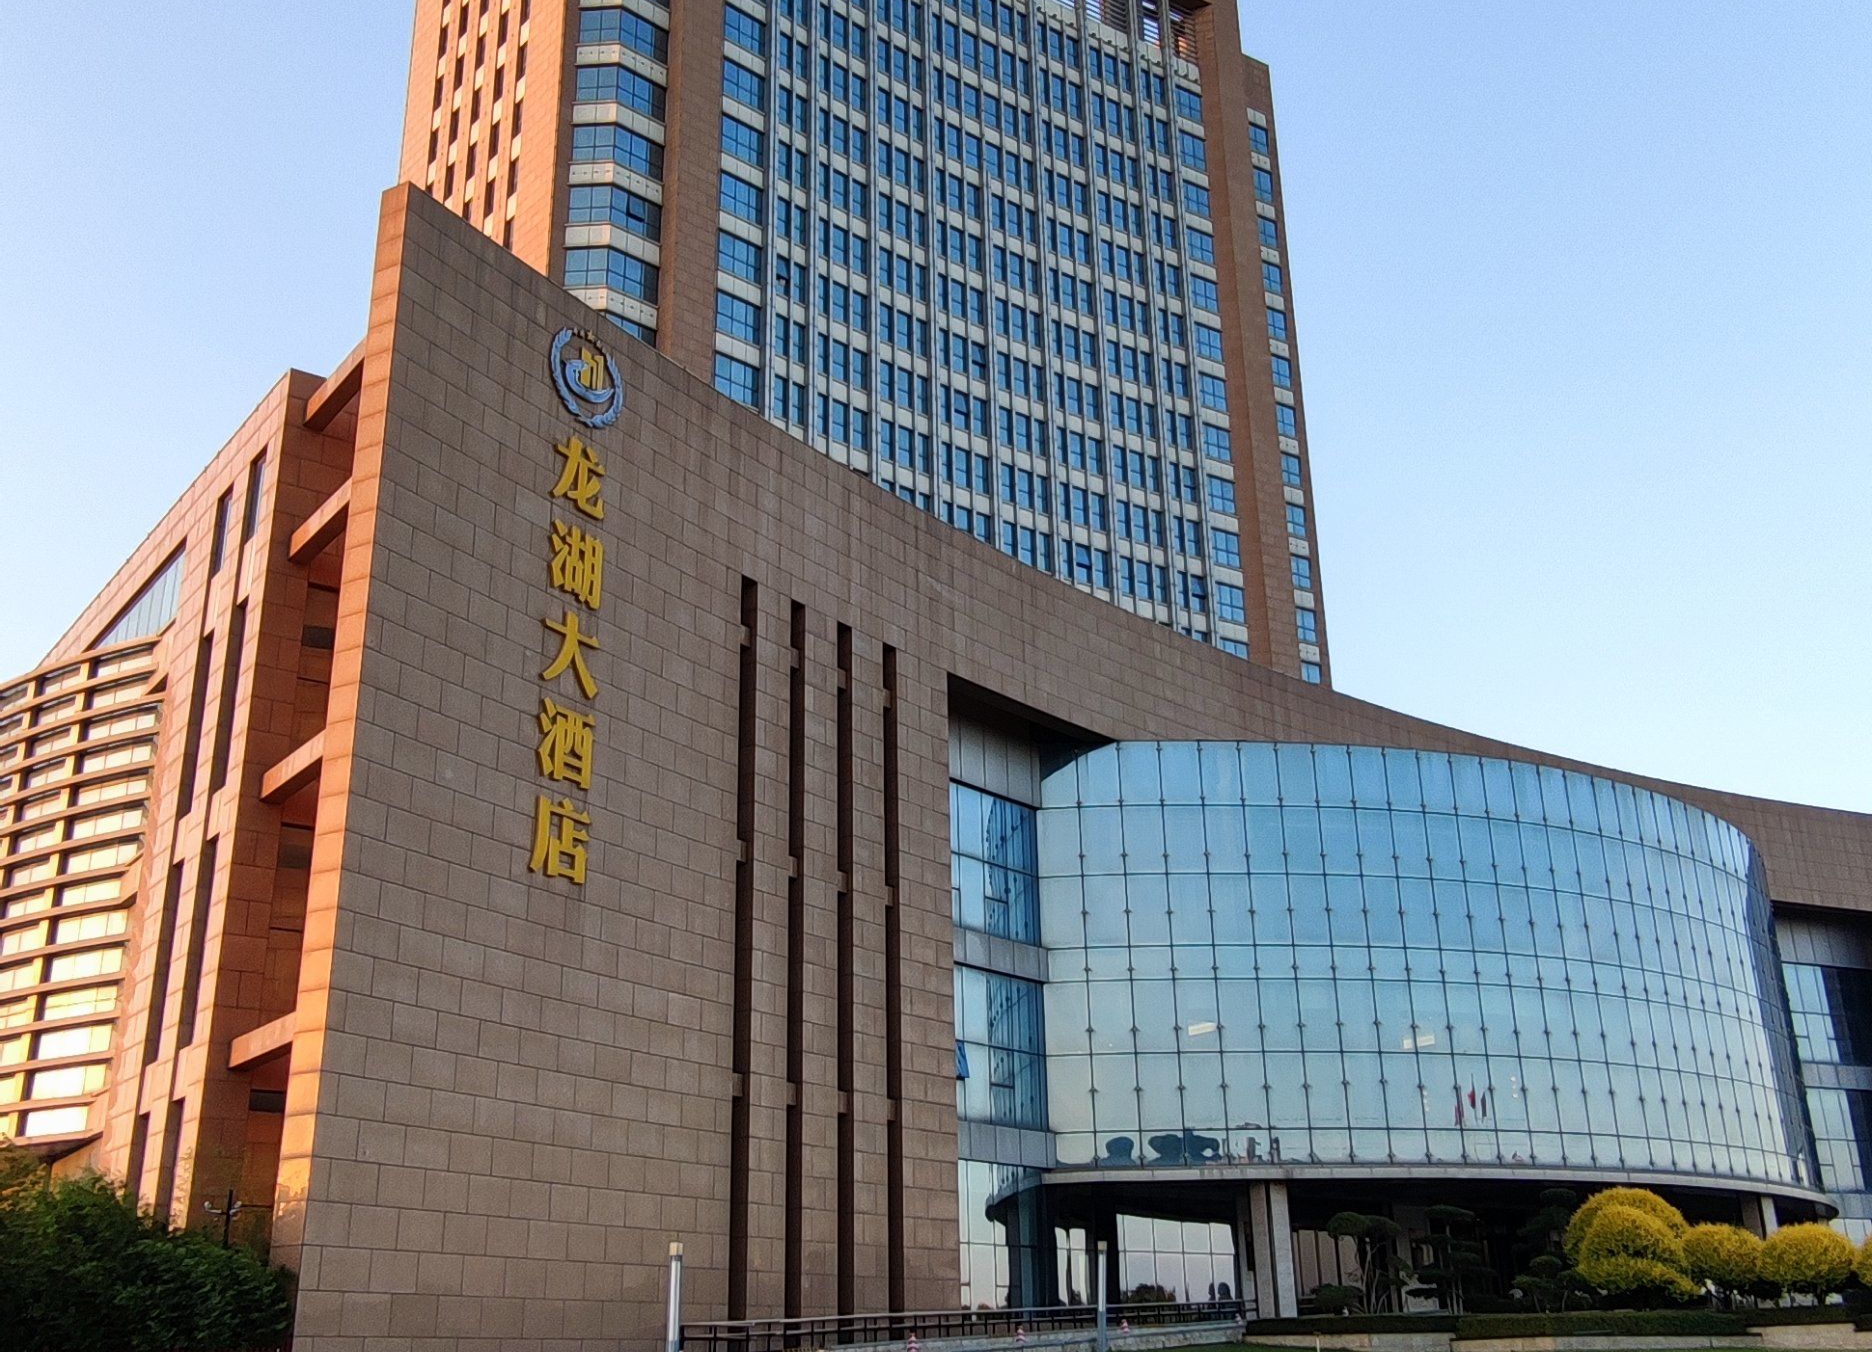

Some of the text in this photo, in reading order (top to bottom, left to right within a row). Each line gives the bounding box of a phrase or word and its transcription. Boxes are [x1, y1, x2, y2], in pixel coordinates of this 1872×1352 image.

[529, 435, 606, 885] 龙湖大酒店
